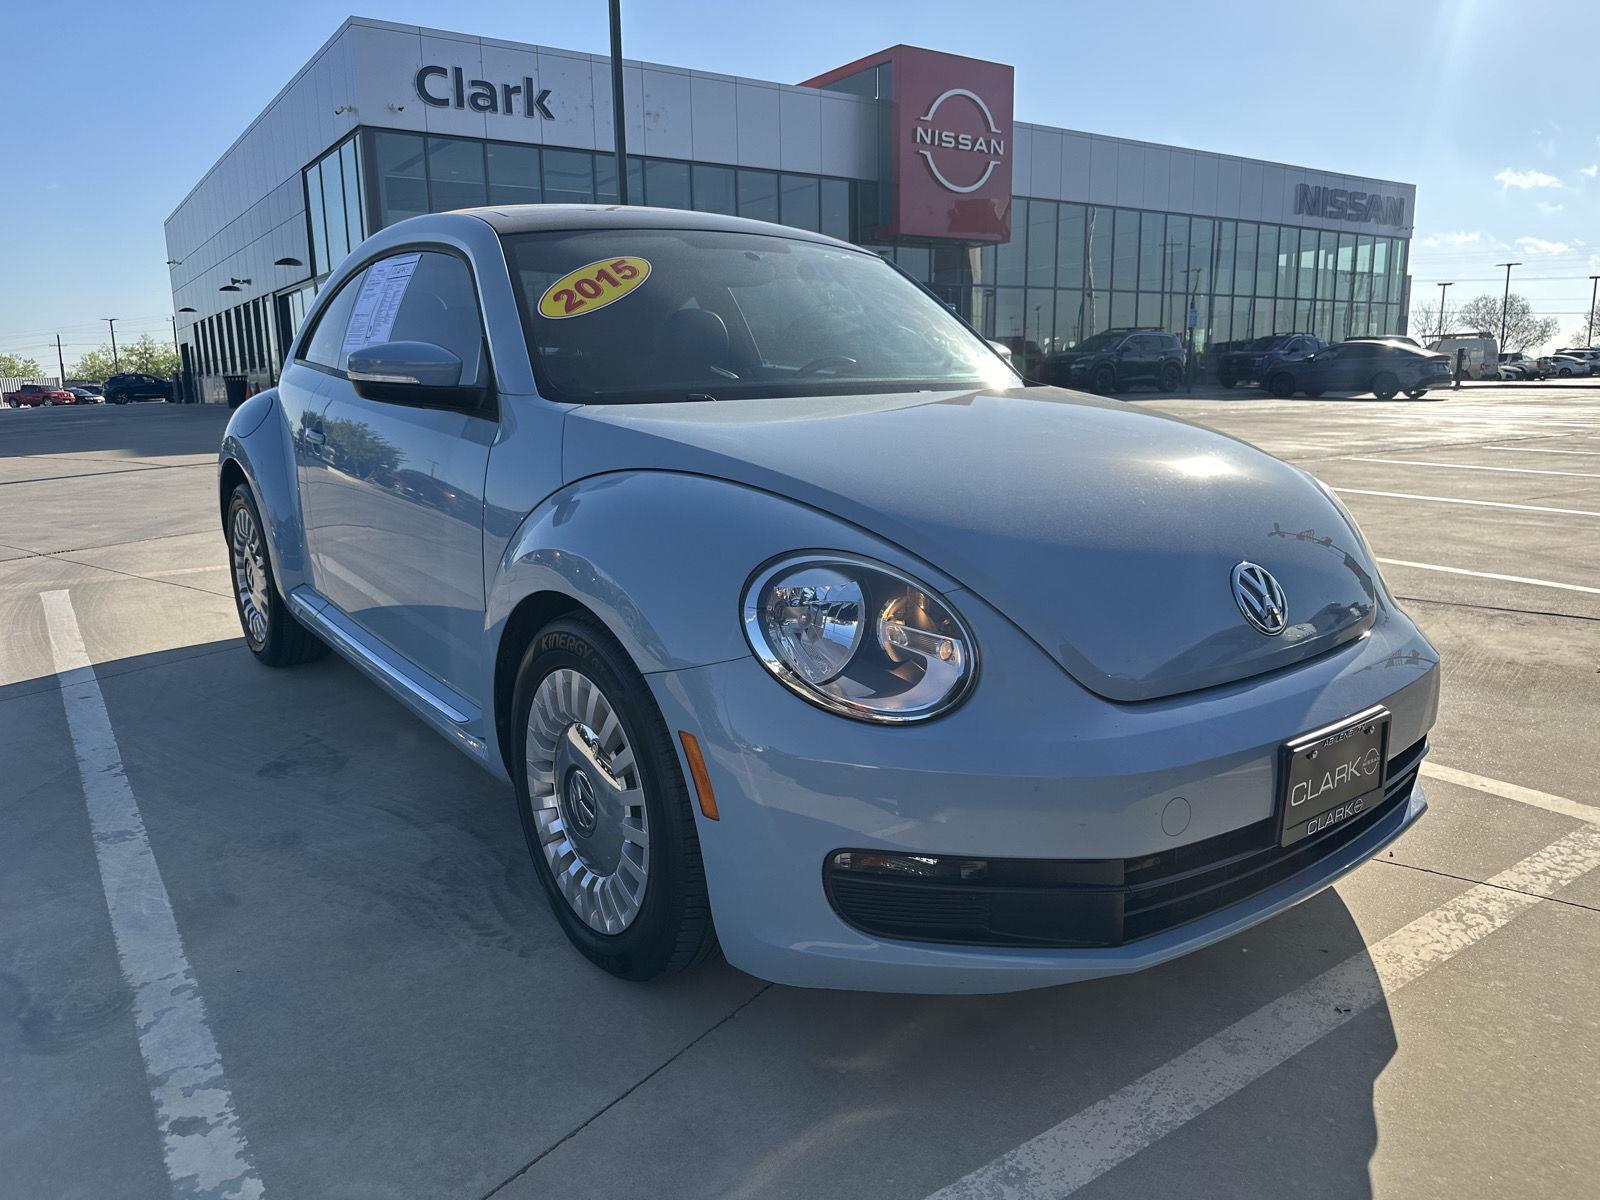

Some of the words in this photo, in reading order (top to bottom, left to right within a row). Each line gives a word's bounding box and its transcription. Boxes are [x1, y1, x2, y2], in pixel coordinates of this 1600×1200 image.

[415, 65, 556, 121] Clark
[915, 126, 1004, 156] NISSAN
[1295, 183, 1405, 226] NISSAN
[553, 259, 640, 314] 2015
[1291, 756, 1361, 806] CLARK
[1307, 802, 1353, 835] CLARK
